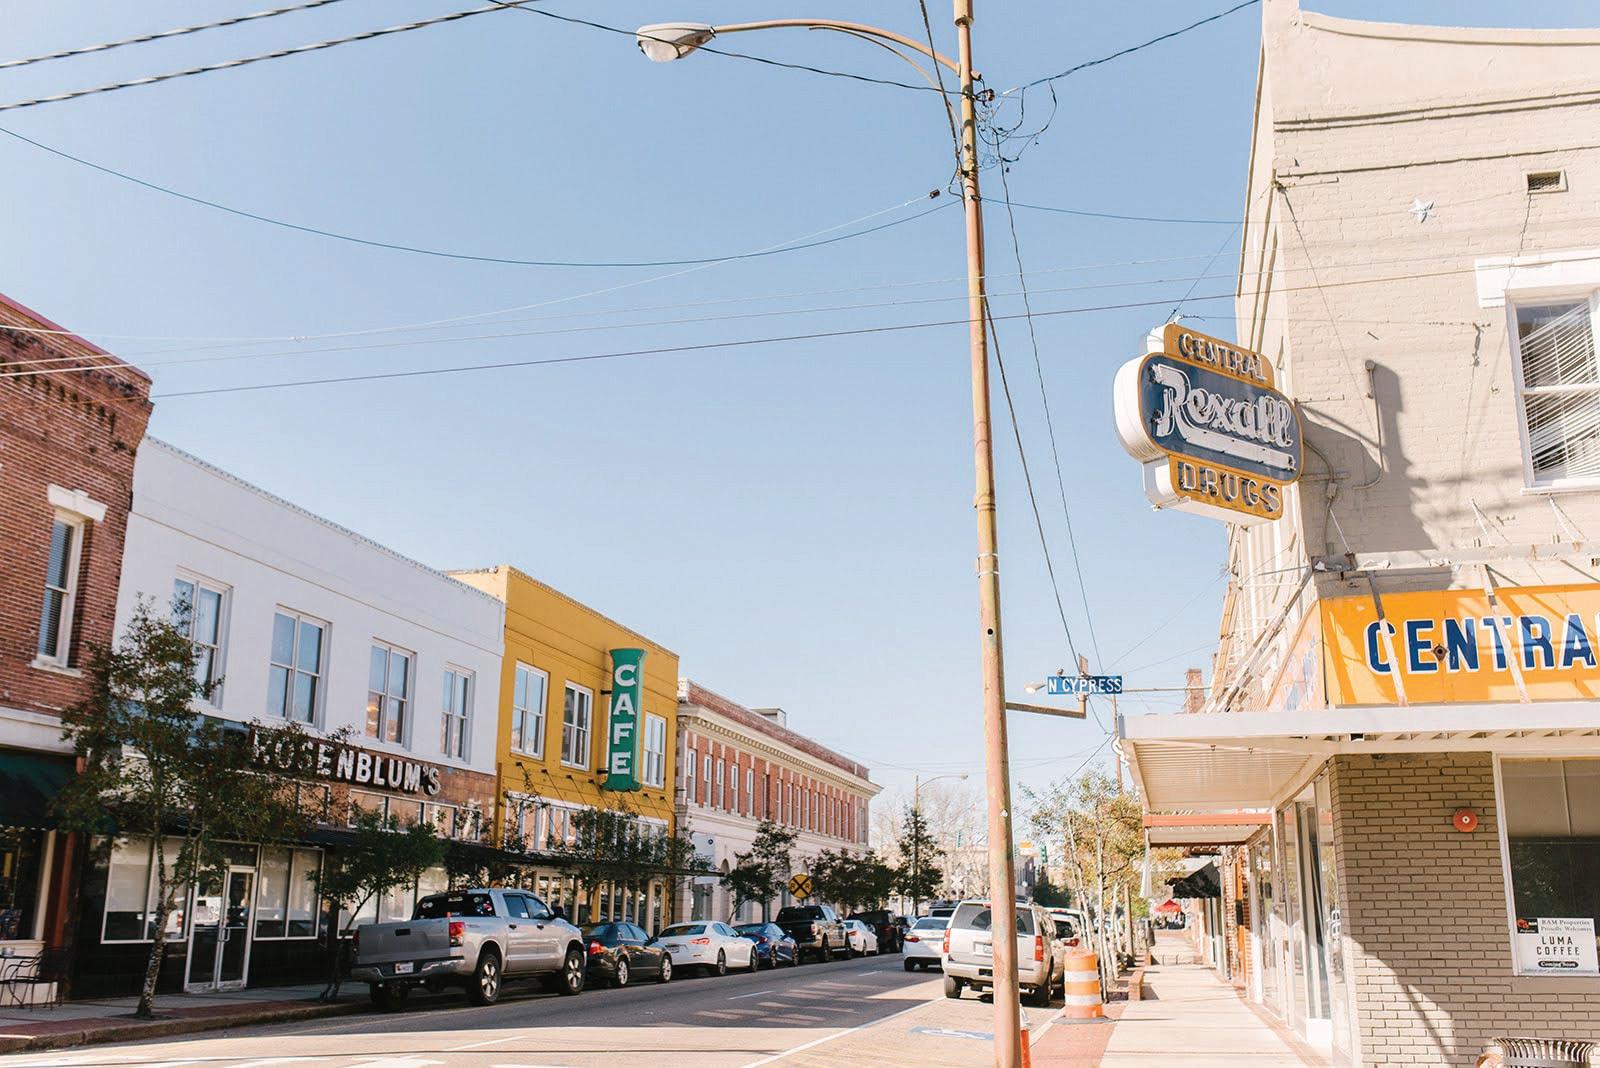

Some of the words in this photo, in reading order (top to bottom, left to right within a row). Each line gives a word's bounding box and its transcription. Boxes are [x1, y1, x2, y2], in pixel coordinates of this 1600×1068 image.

[1178, 333, 1267, 381] CENTRAL
[1150, 363, 1296, 471] Rexall
[1178, 461, 1281, 513] DRUGS
[1363, 613, 1600, 676] CENTRA
[1048, 678, 1057, 693] N
[1062, 678, 1122, 693] CYPRESS
[611, 663, 637, 775] CAFE
[1536, 946, 1580, 956] COFFEE
[1541, 936, 1573, 945] LUMA
